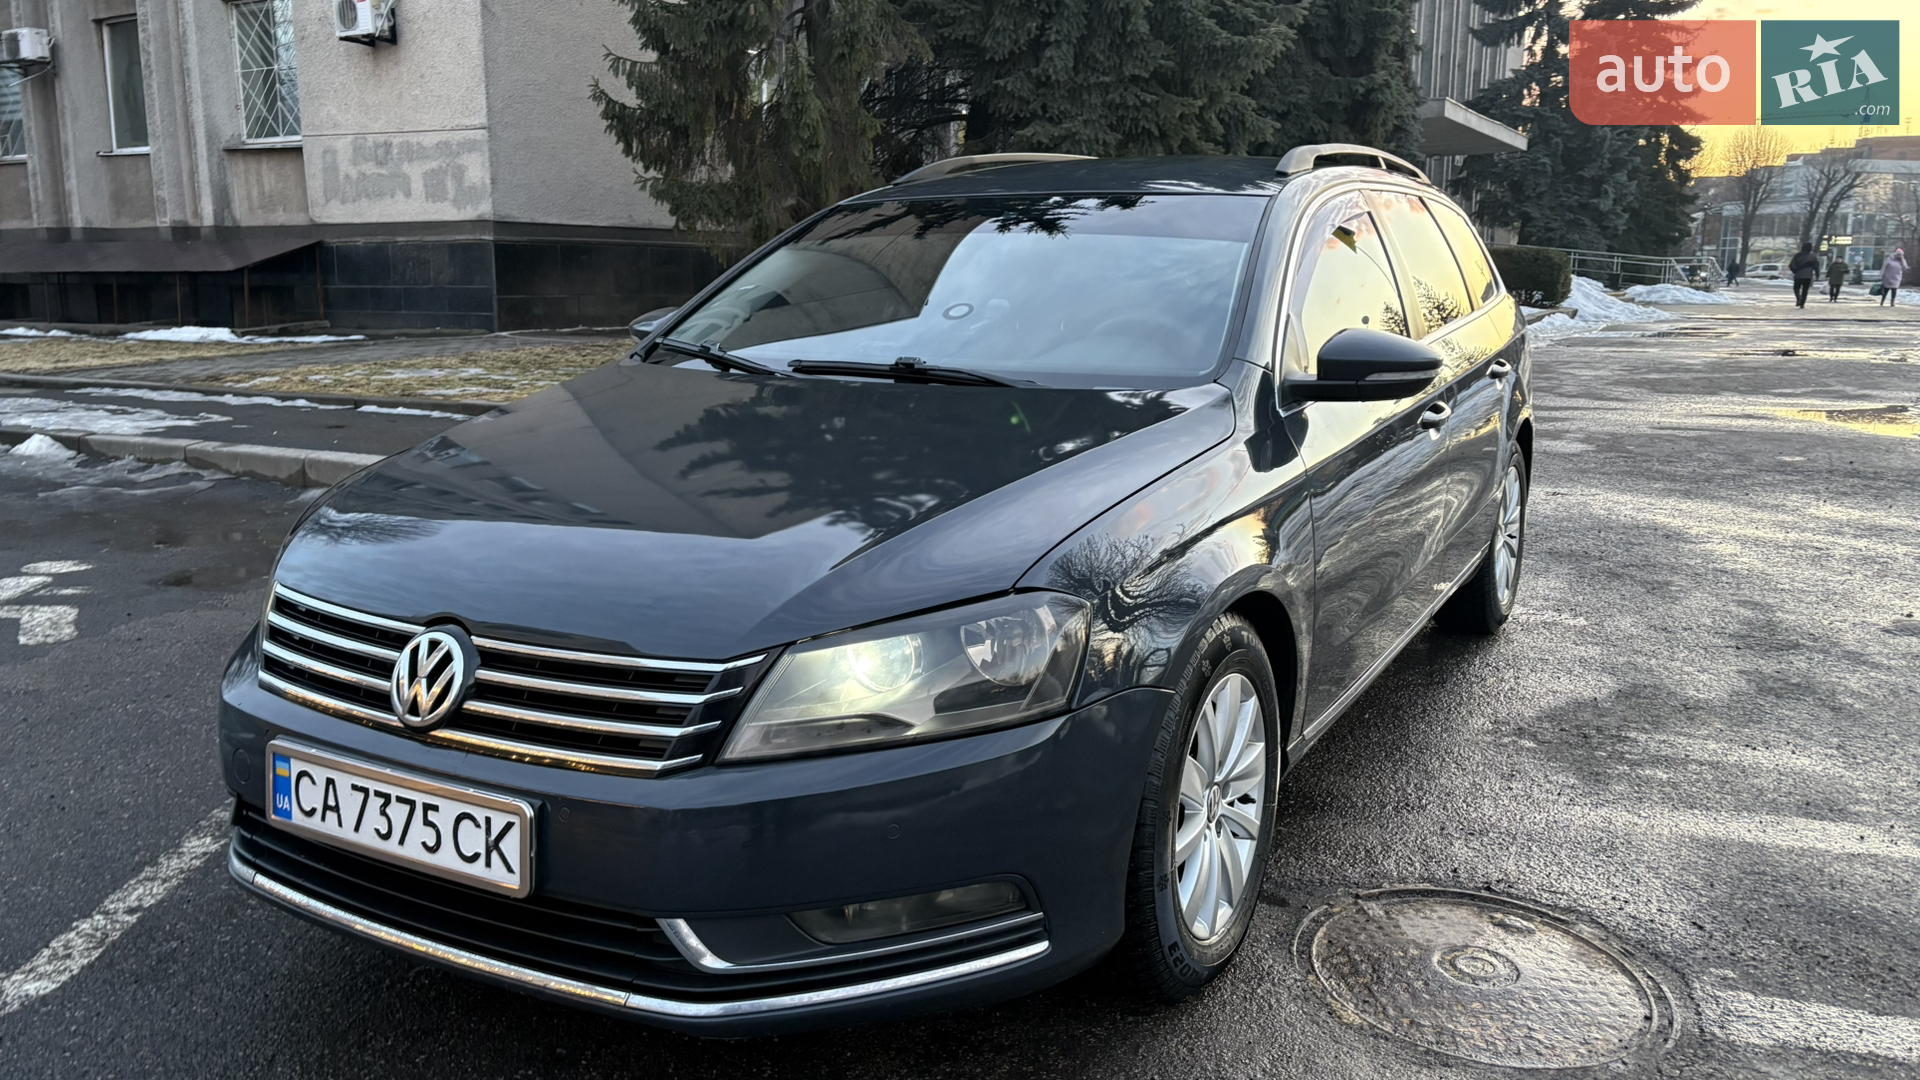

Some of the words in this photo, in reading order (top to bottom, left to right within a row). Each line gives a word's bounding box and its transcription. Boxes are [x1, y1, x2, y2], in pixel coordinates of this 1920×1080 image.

[276, 794, 290, 811] UA
[294, 769, 344, 828] CA
[350, 783, 442, 854] 7375
[452, 811, 517, 875] CK
